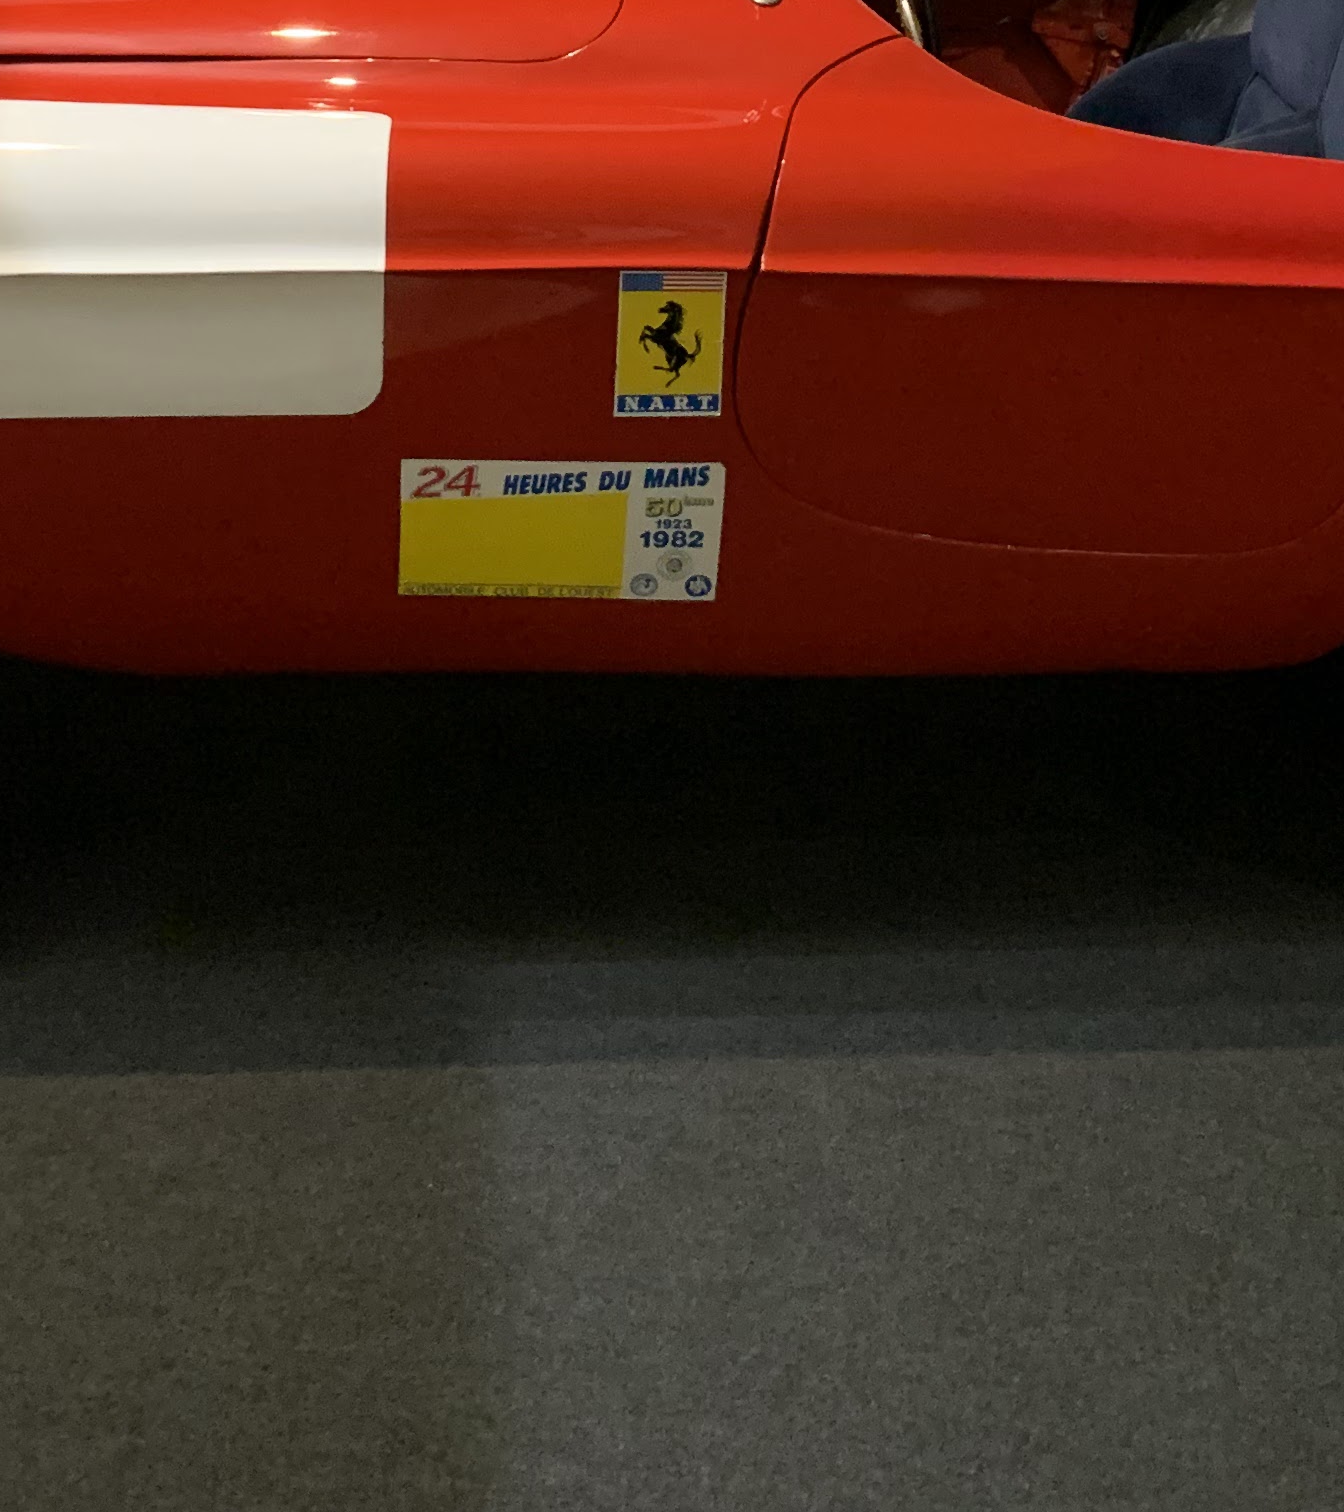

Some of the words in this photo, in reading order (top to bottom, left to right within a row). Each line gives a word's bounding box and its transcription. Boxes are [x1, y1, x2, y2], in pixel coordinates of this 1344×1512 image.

[624, 396, 714, 411] N.A.R.T.
[410, 464, 481, 498] 24
[503, 472, 587, 495] HEURES
[599, 470, 632, 491] DU
[644, 465, 711, 488] MANS
[656, 518, 693, 529] 1923
[640, 530, 705, 548] 1982
